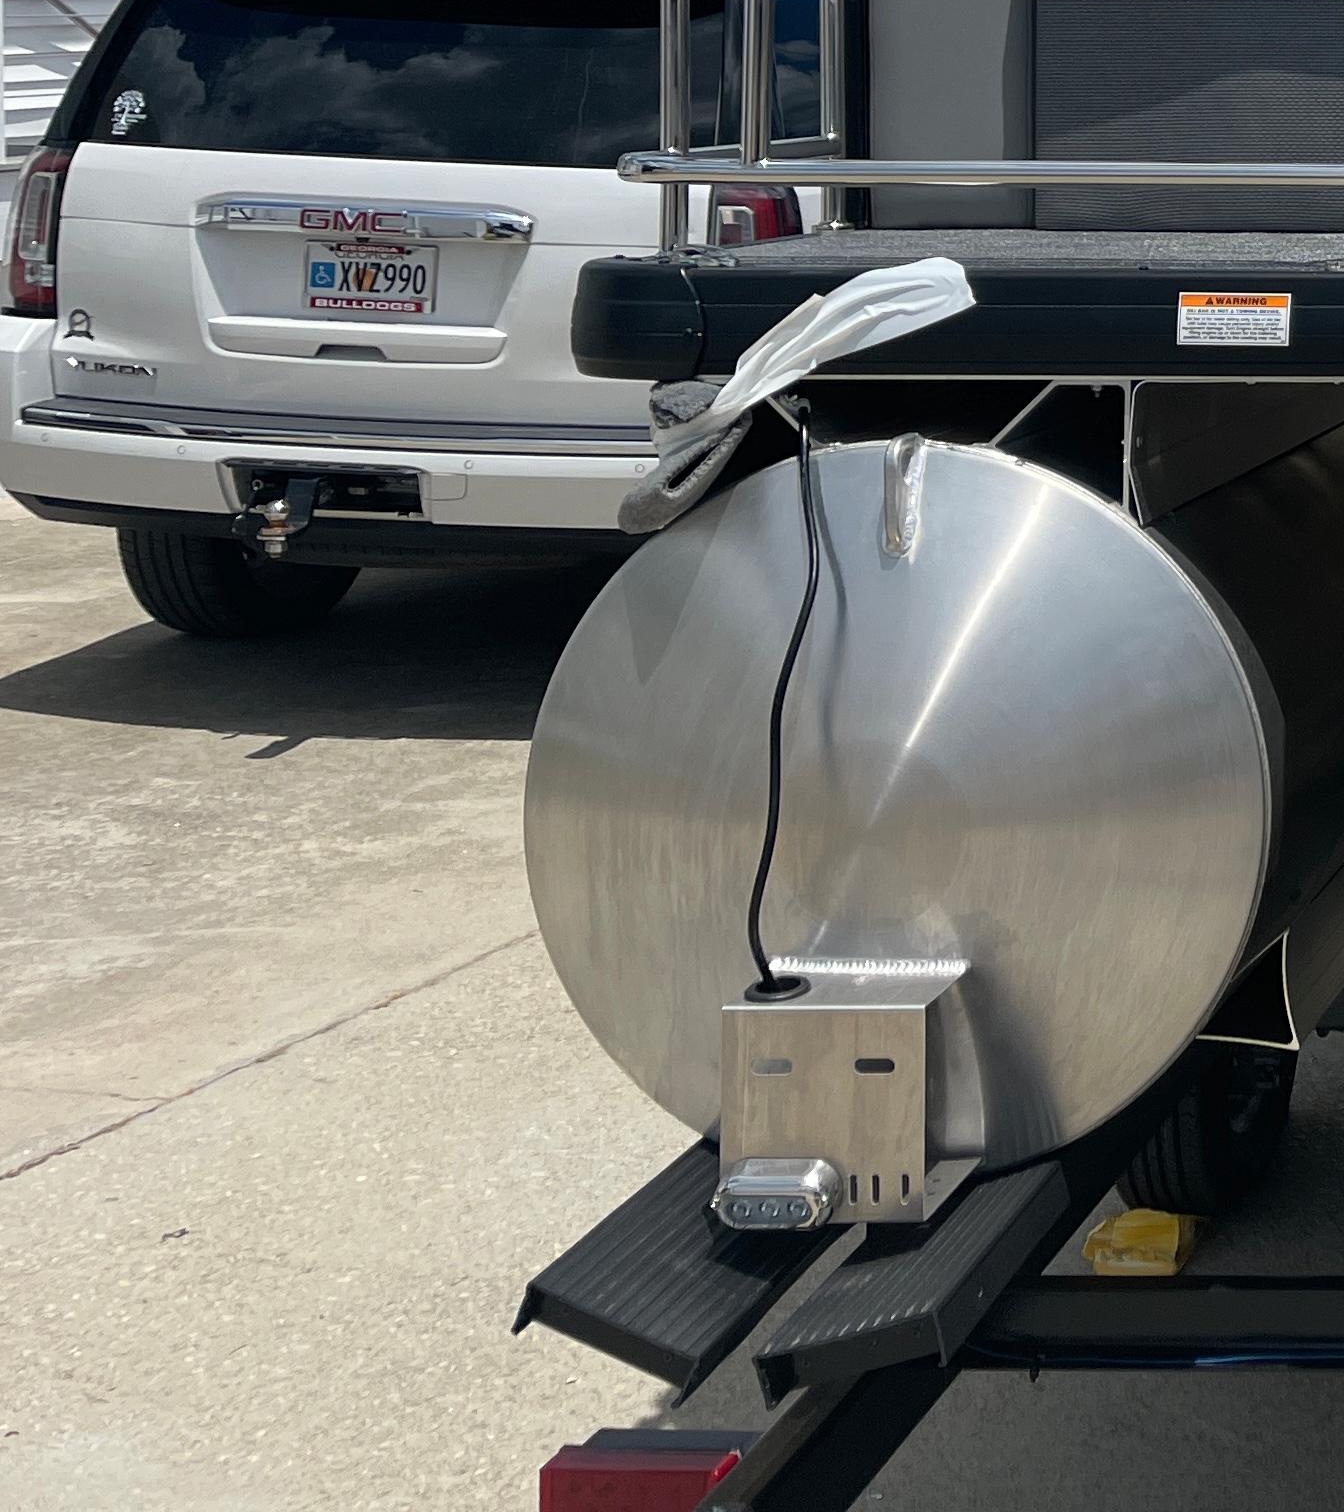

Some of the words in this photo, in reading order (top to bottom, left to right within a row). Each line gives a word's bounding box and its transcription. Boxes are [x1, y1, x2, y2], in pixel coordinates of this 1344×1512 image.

[301, 208, 405, 232] GMC
[340, 245, 398, 253] GEORGIA
[338, 261, 426, 295] XVZ990
[315, 298, 417, 311] BULLDOGS
[1216, 297, 1267, 305] WARNING
